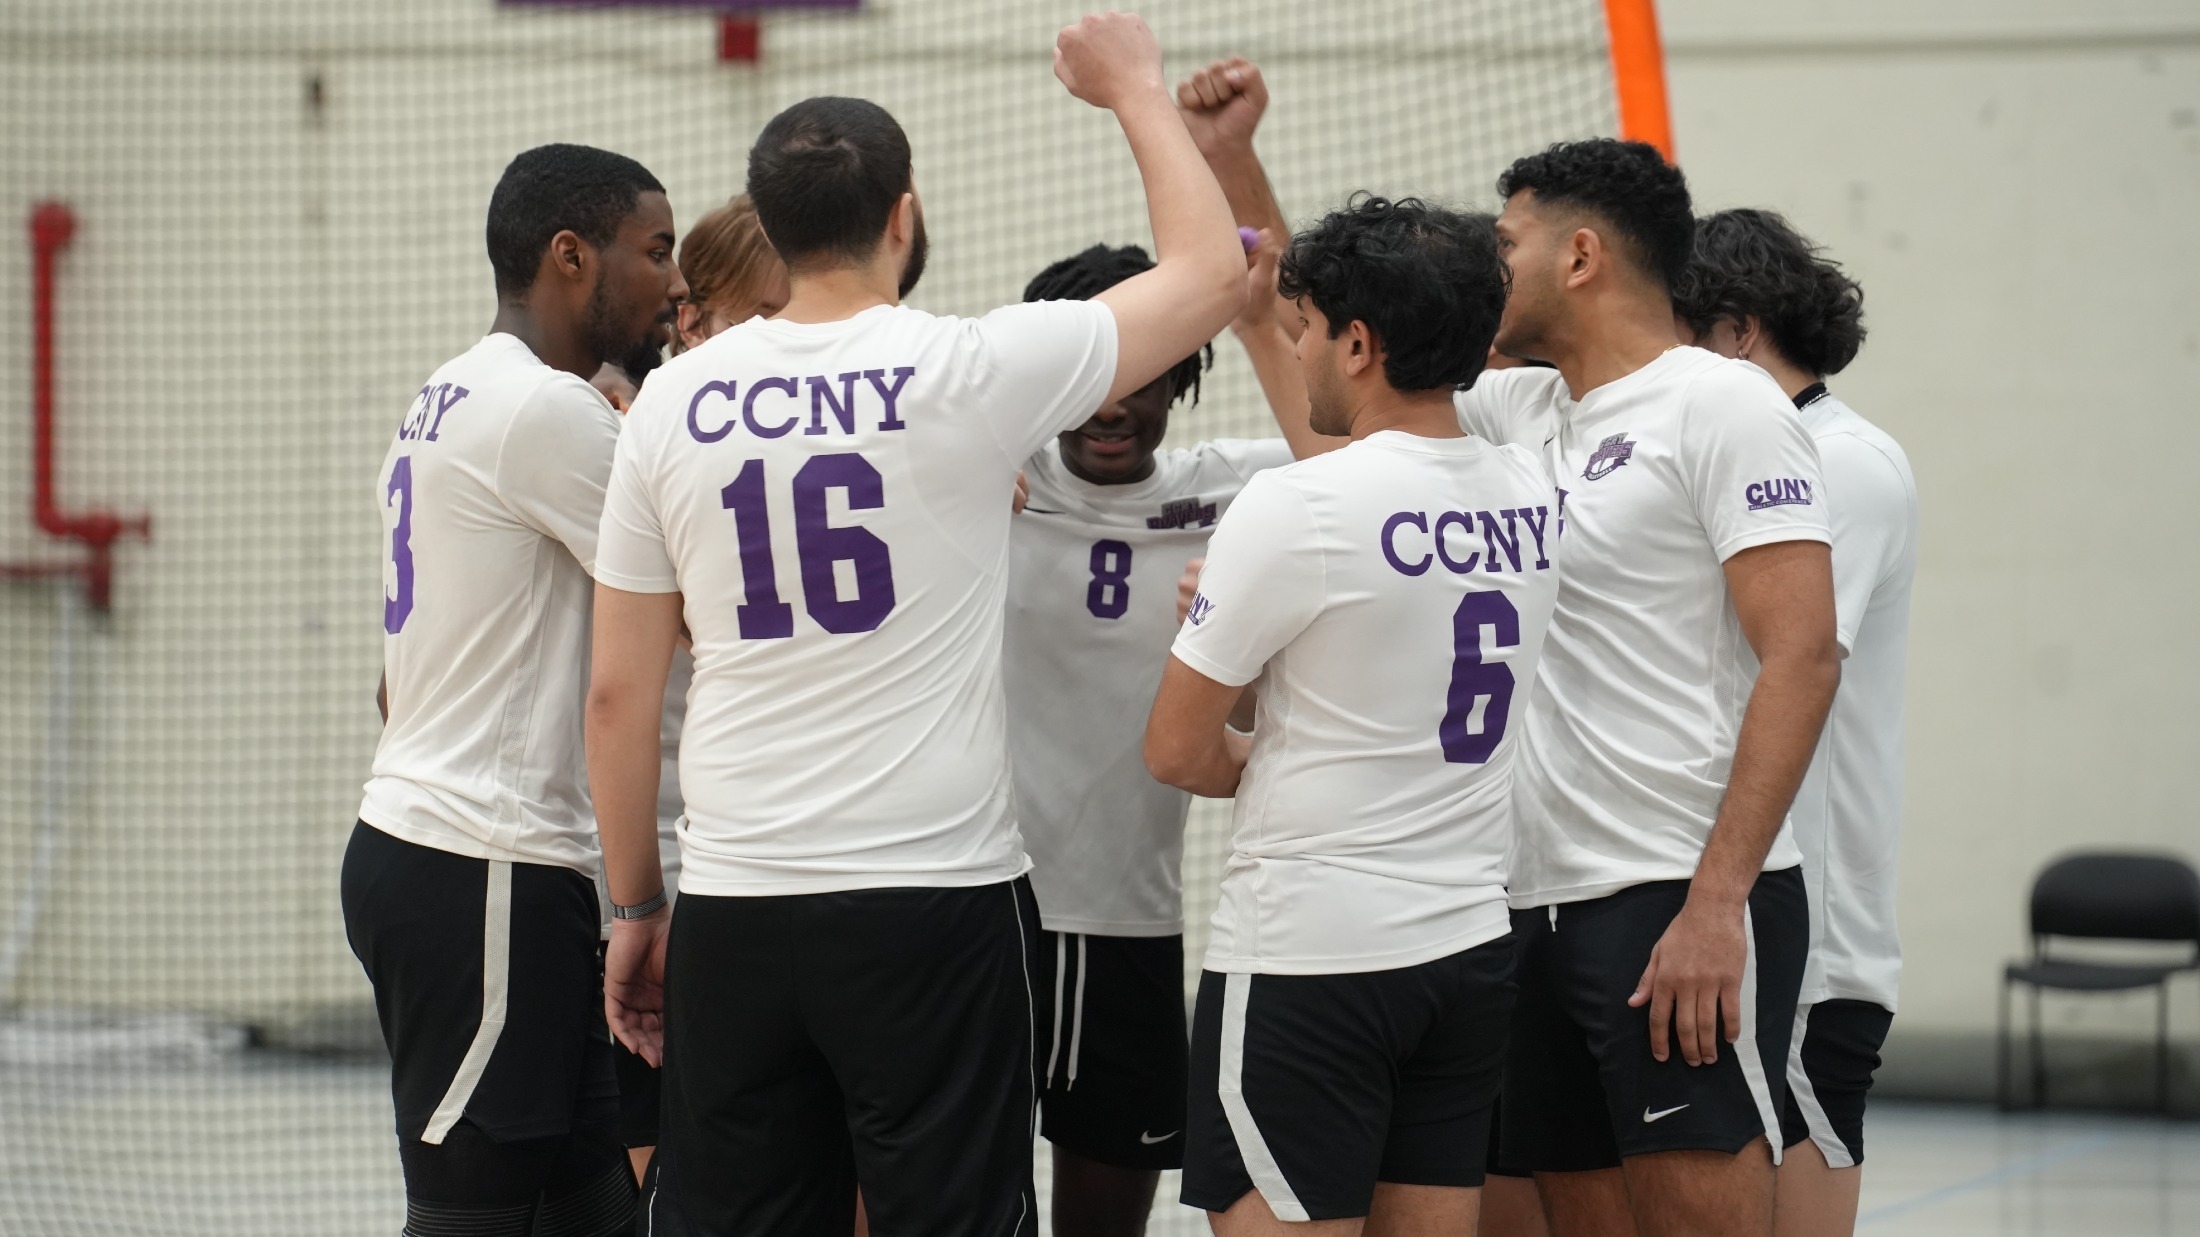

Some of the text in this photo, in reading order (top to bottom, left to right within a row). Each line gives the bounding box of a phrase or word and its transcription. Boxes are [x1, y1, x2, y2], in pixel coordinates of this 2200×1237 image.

[399, 382, 470, 442] CNY
[687, 366, 915, 443] CCNY
[1745, 478, 1812, 505] CUNY
[384, 455, 415, 635] 3
[721, 452, 897, 640] 16
[1086, 538, 1133, 620] 8
[1381, 505, 1550, 577] CCNY
[1189, 591, 1216, 622] NY
[1439, 589, 1520, 764] 6
